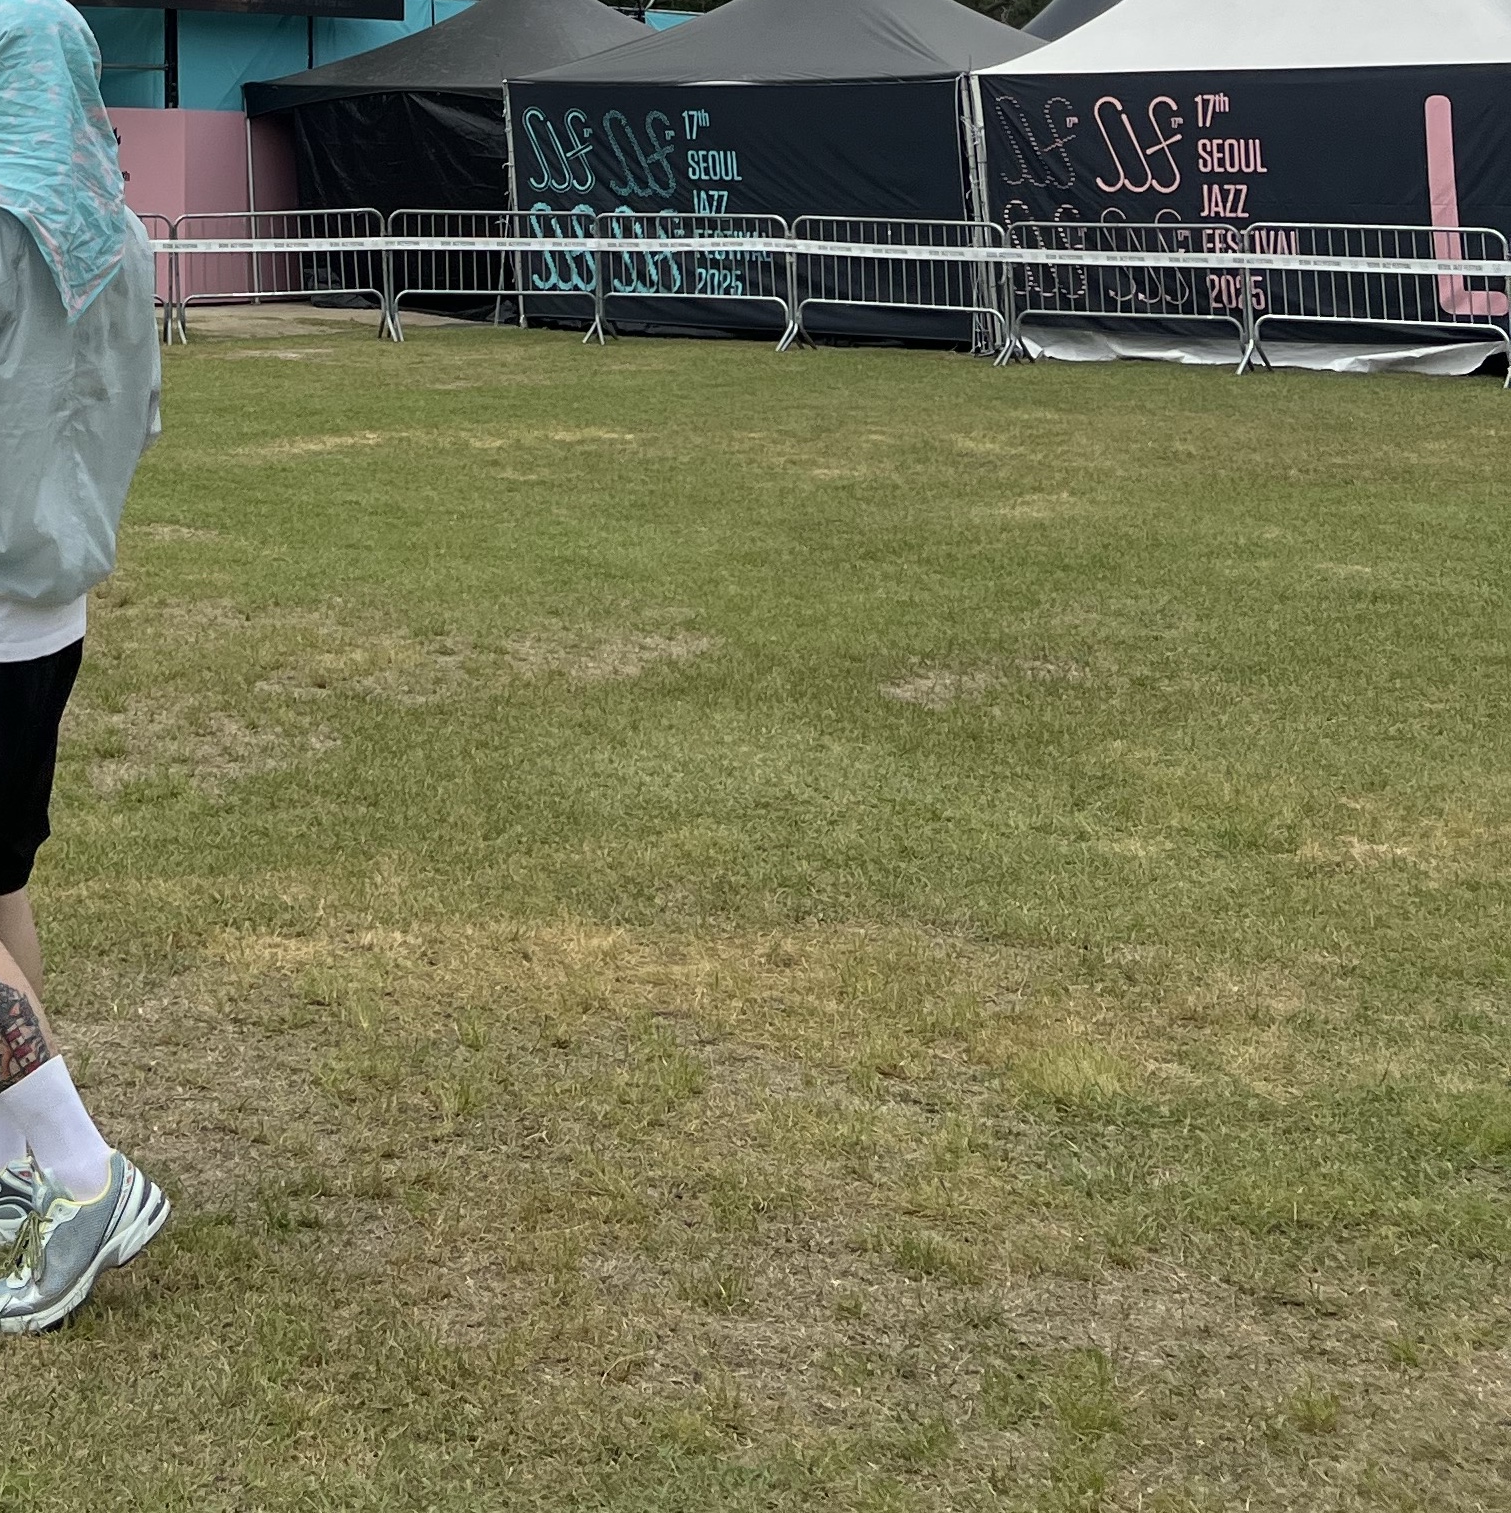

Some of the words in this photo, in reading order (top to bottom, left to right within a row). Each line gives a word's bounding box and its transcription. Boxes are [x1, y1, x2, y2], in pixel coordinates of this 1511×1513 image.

[682, 109, 710, 139] 17th
[1194, 92, 1229, 128] 17th
[688, 150, 742, 181] SEOUL
[1197, 138, 1268, 173] SEOUL
[1199, 184, 1250, 218] JAZZ
